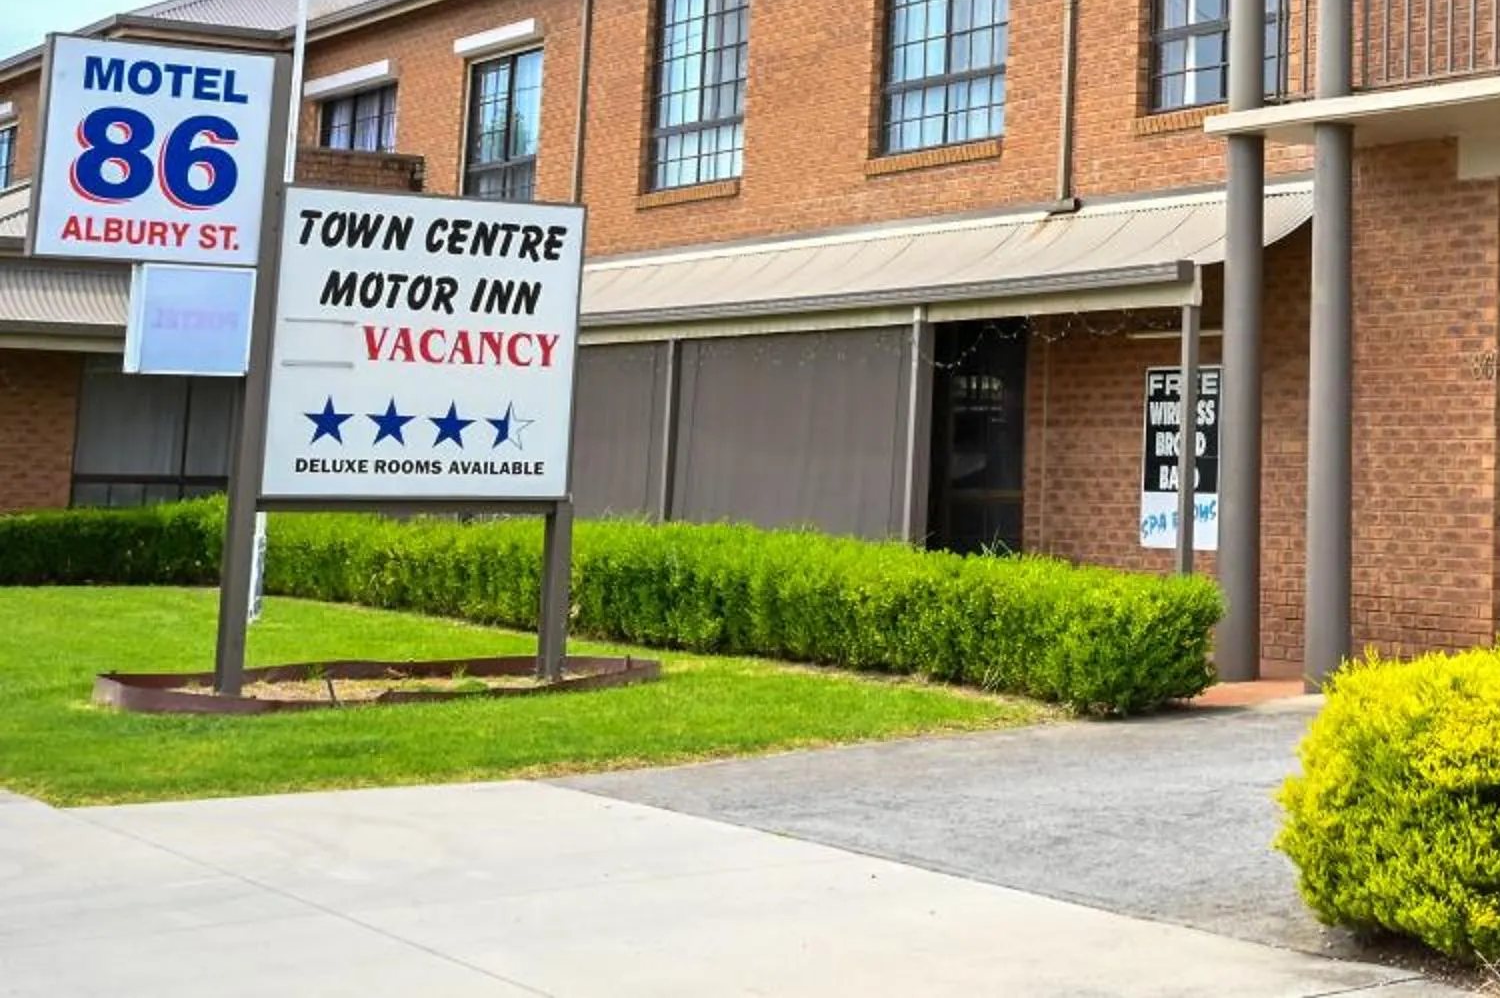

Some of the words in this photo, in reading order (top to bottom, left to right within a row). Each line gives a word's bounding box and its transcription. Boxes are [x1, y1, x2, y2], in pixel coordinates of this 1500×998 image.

[84, 56, 248, 104] MOTEL
[69, 106, 239, 210] 86
[61, 215, 190, 247] ALBURY
[199, 224, 239, 251] ST.
[299, 209, 414, 250] TOWN
[425, 218, 567, 262] CENTRE
[320, 270, 458, 314] MOTOR
[470, 278, 542, 315] INN
[363, 325, 560, 367] VACANCY
[1149, 373, 1218, 396] FRE
[1150, 400, 1215, 426] WIRSS
[1155, 431, 1206, 457] BROD
[295, 457, 368, 474] DELUXE
[374, 459, 442, 475] ROOMS
[448, 461, 544, 476] AVAILABLE
